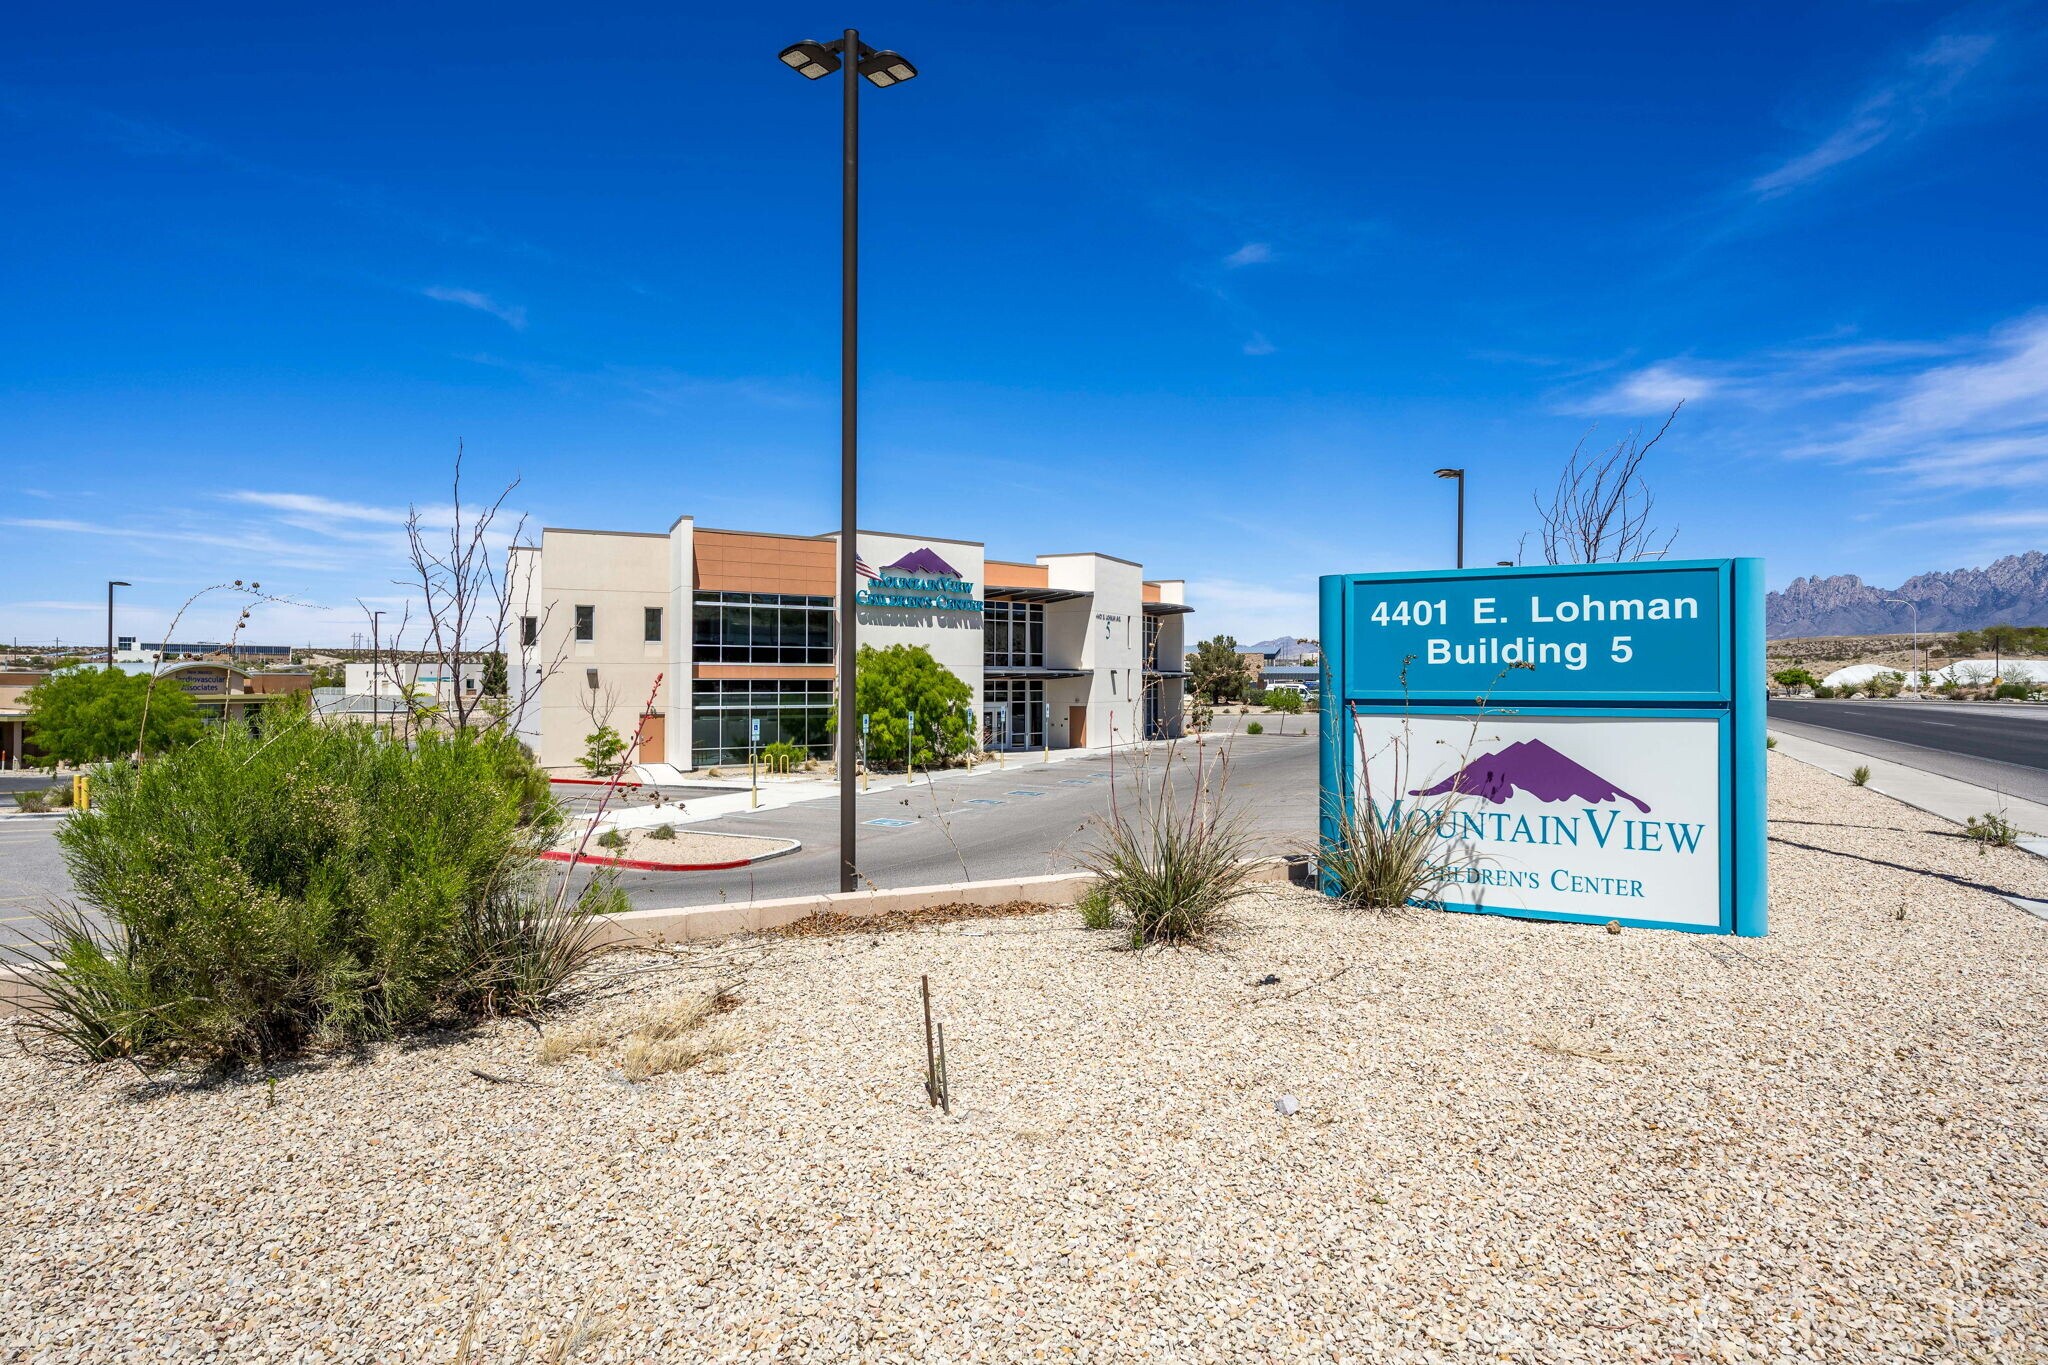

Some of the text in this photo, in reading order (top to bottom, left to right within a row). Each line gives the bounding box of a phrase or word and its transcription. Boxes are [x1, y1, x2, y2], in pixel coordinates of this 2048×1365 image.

[1371, 594, 1698, 626] 4401 E. Lohman
[1427, 636, 1633, 671] Building 5
[1550, 869, 1645, 898] CENTER
